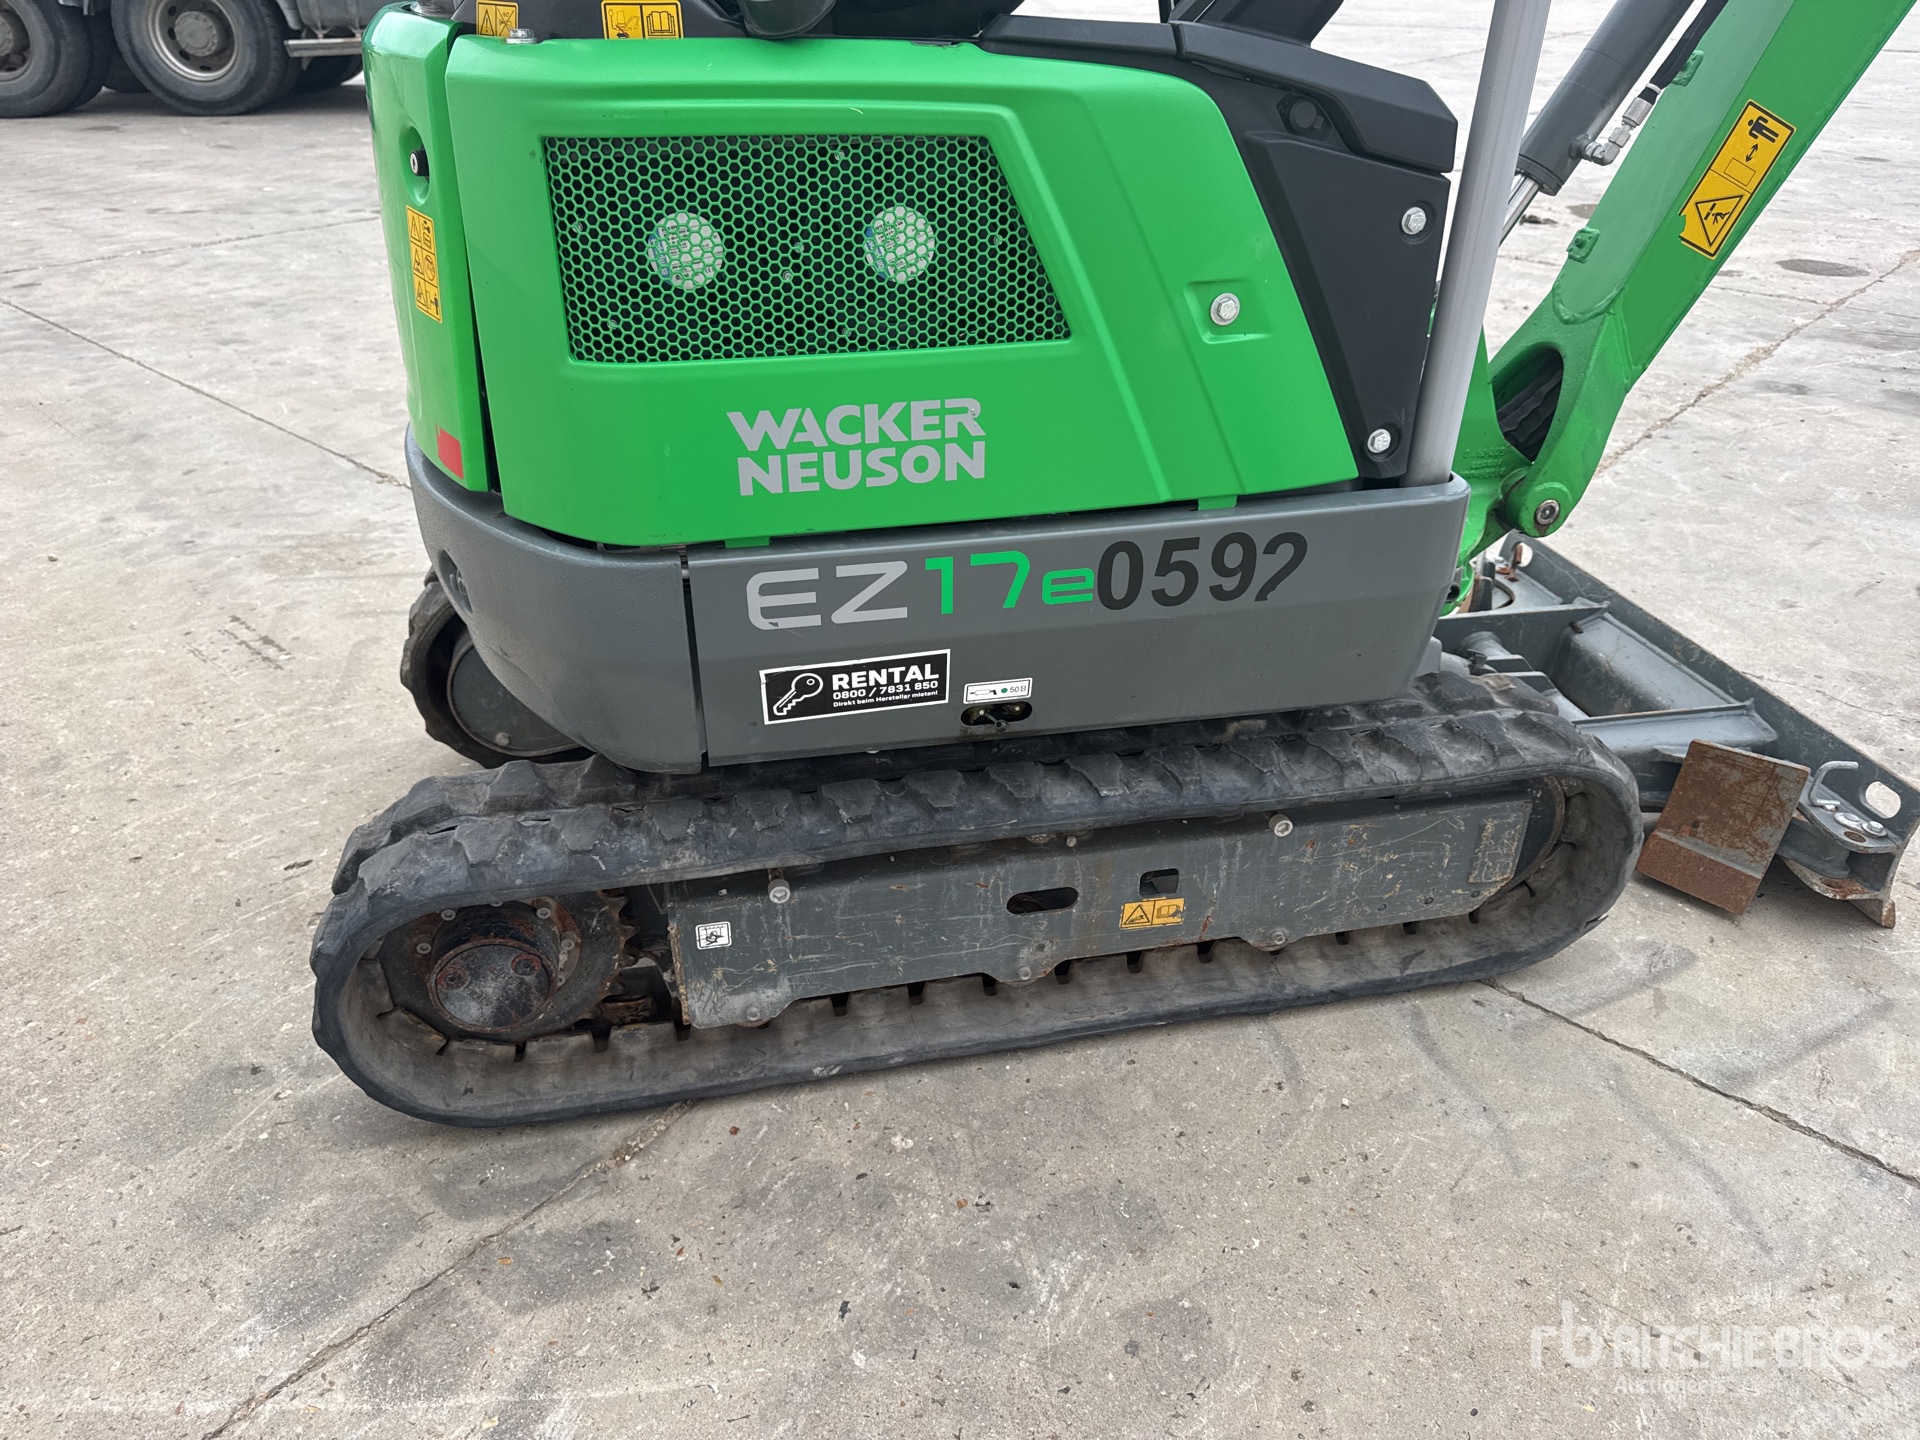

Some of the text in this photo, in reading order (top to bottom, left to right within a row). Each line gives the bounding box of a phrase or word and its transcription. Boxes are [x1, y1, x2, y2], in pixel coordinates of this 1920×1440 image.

[726, 398, 986, 451] WACKER
[737, 441, 985, 496] NEUSON
[1097, 532, 1308, 610] 0592
[832, 663, 940, 690] RENTAL
[833, 680, 938, 700] 0800 / 7831 850
[876, 693, 911, 702] Hersteller
[911, 689, 938, 698] mieten!
